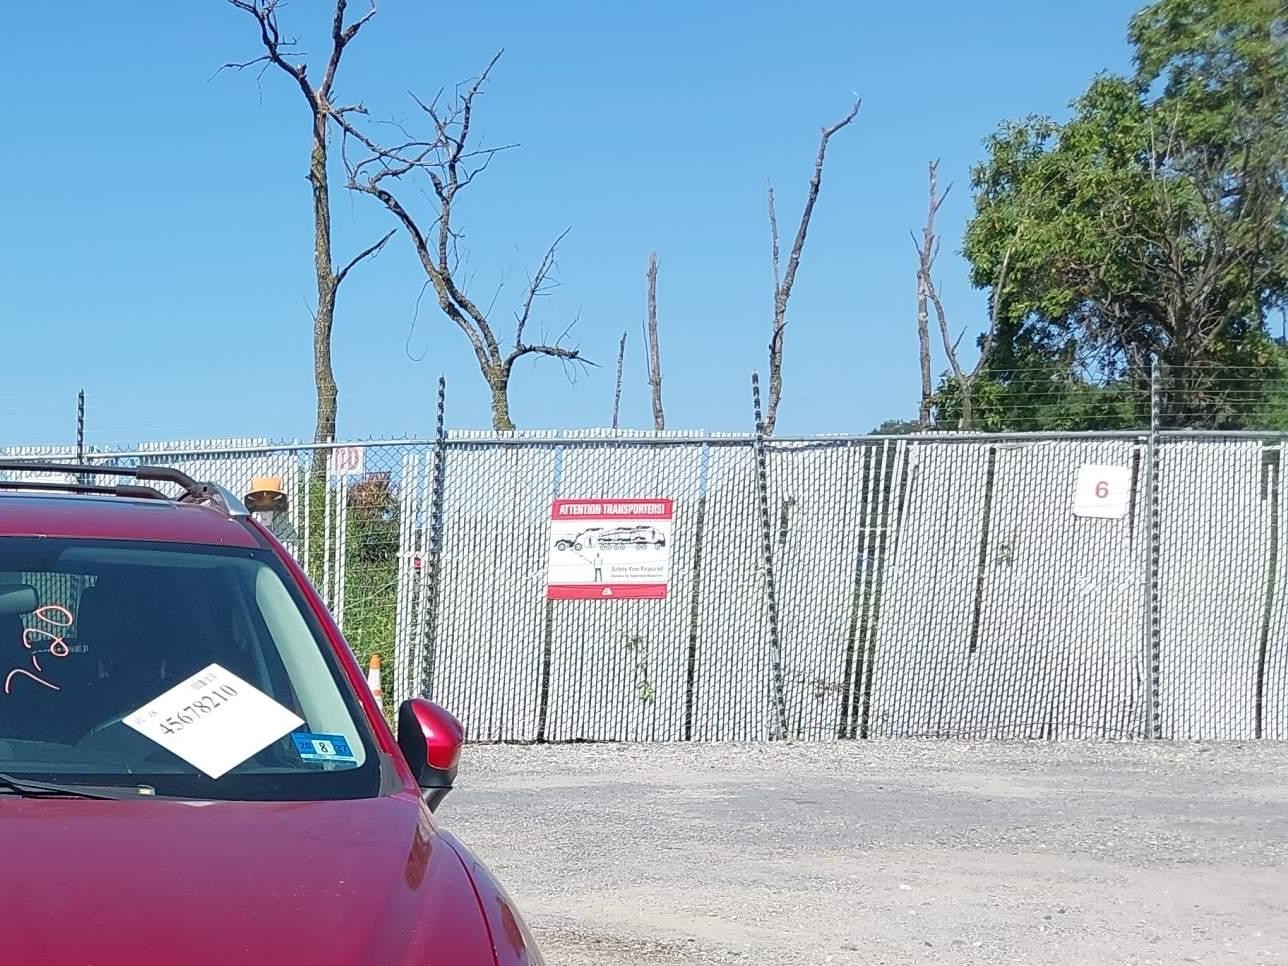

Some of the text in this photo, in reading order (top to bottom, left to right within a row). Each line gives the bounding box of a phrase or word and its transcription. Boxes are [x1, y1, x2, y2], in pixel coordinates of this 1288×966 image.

[1095, 480, 1109, 499] 6
[559, 503, 666, 515] ATTENTION TRANSPORTERS!
[4, 604, 73, 694] 7-20
[159, 684, 239, 735] 45678210
[318, 742, 329, 753] 8
